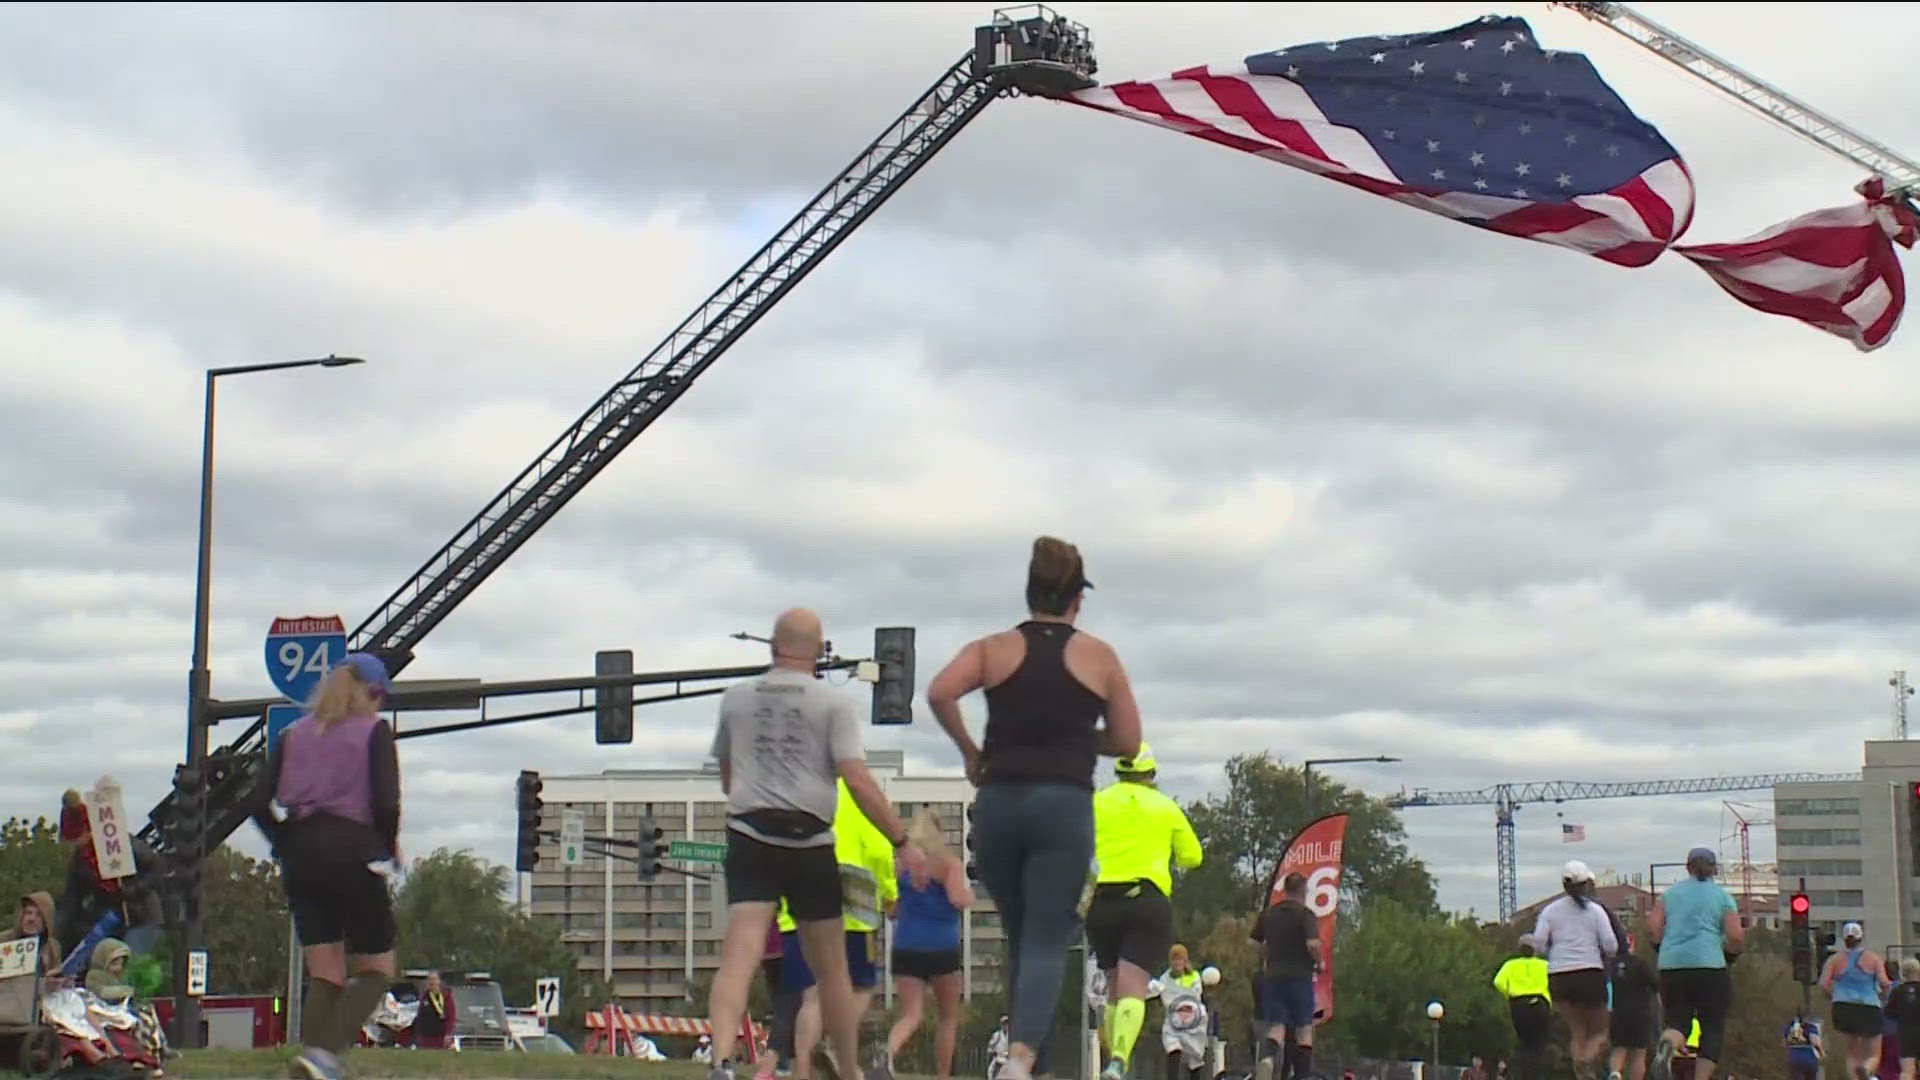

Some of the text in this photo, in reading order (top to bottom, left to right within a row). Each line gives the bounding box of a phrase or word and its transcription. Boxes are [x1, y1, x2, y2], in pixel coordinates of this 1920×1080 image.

[279, 620, 336, 633] INTERSTATE
[279, 641, 331, 682] 94
[98, 805, 122, 856] MOM
[1284, 840, 1342, 868] MILE
[15, 941, 36, 954] GO
